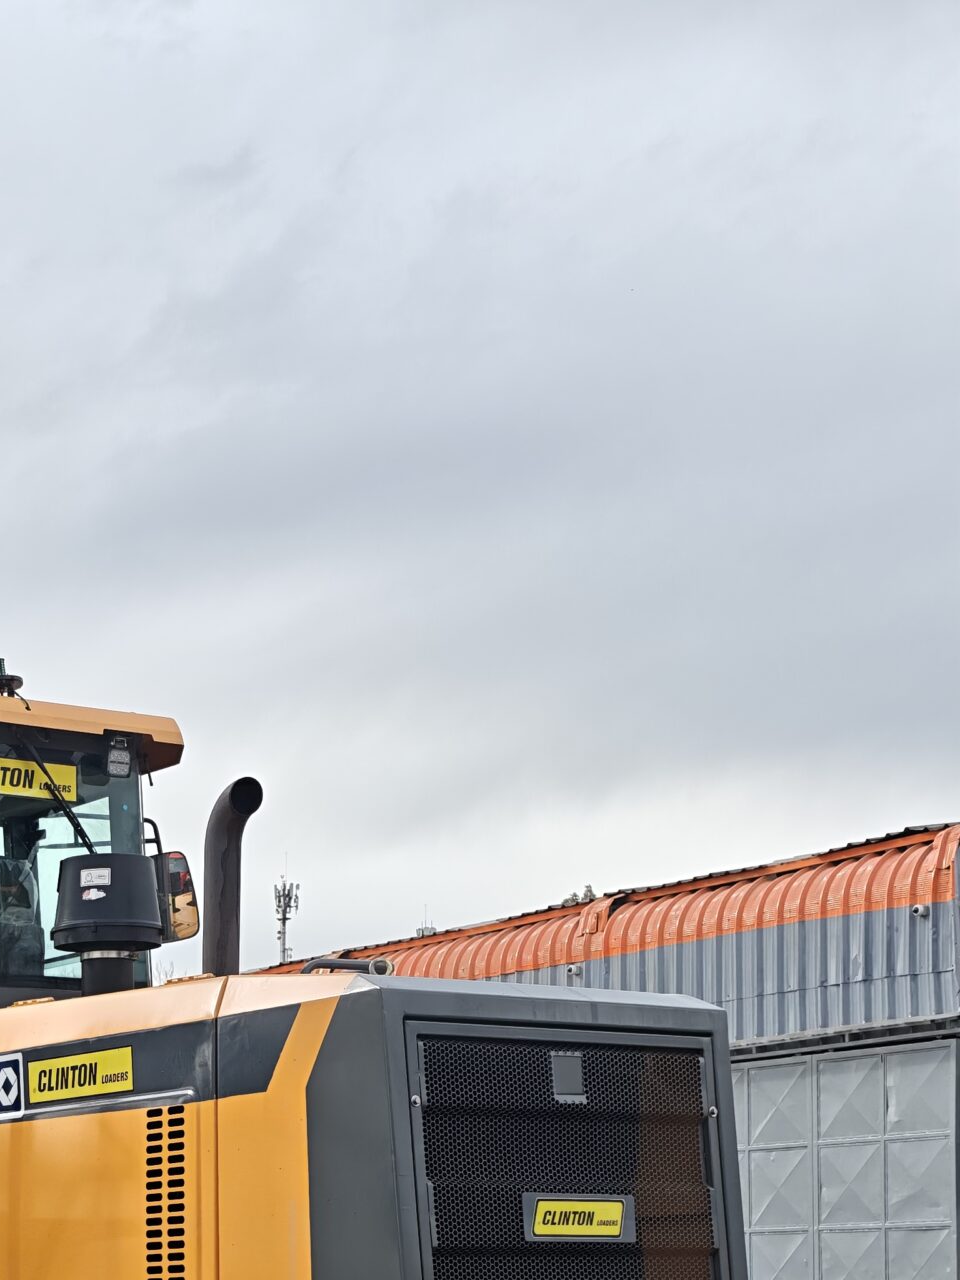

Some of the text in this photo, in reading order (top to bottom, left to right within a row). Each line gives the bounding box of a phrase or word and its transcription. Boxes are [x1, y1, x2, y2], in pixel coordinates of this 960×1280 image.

[38, 1062, 129, 1092] CLINTON LOADERS
[542, 1210, 595, 1226] CLINTON
